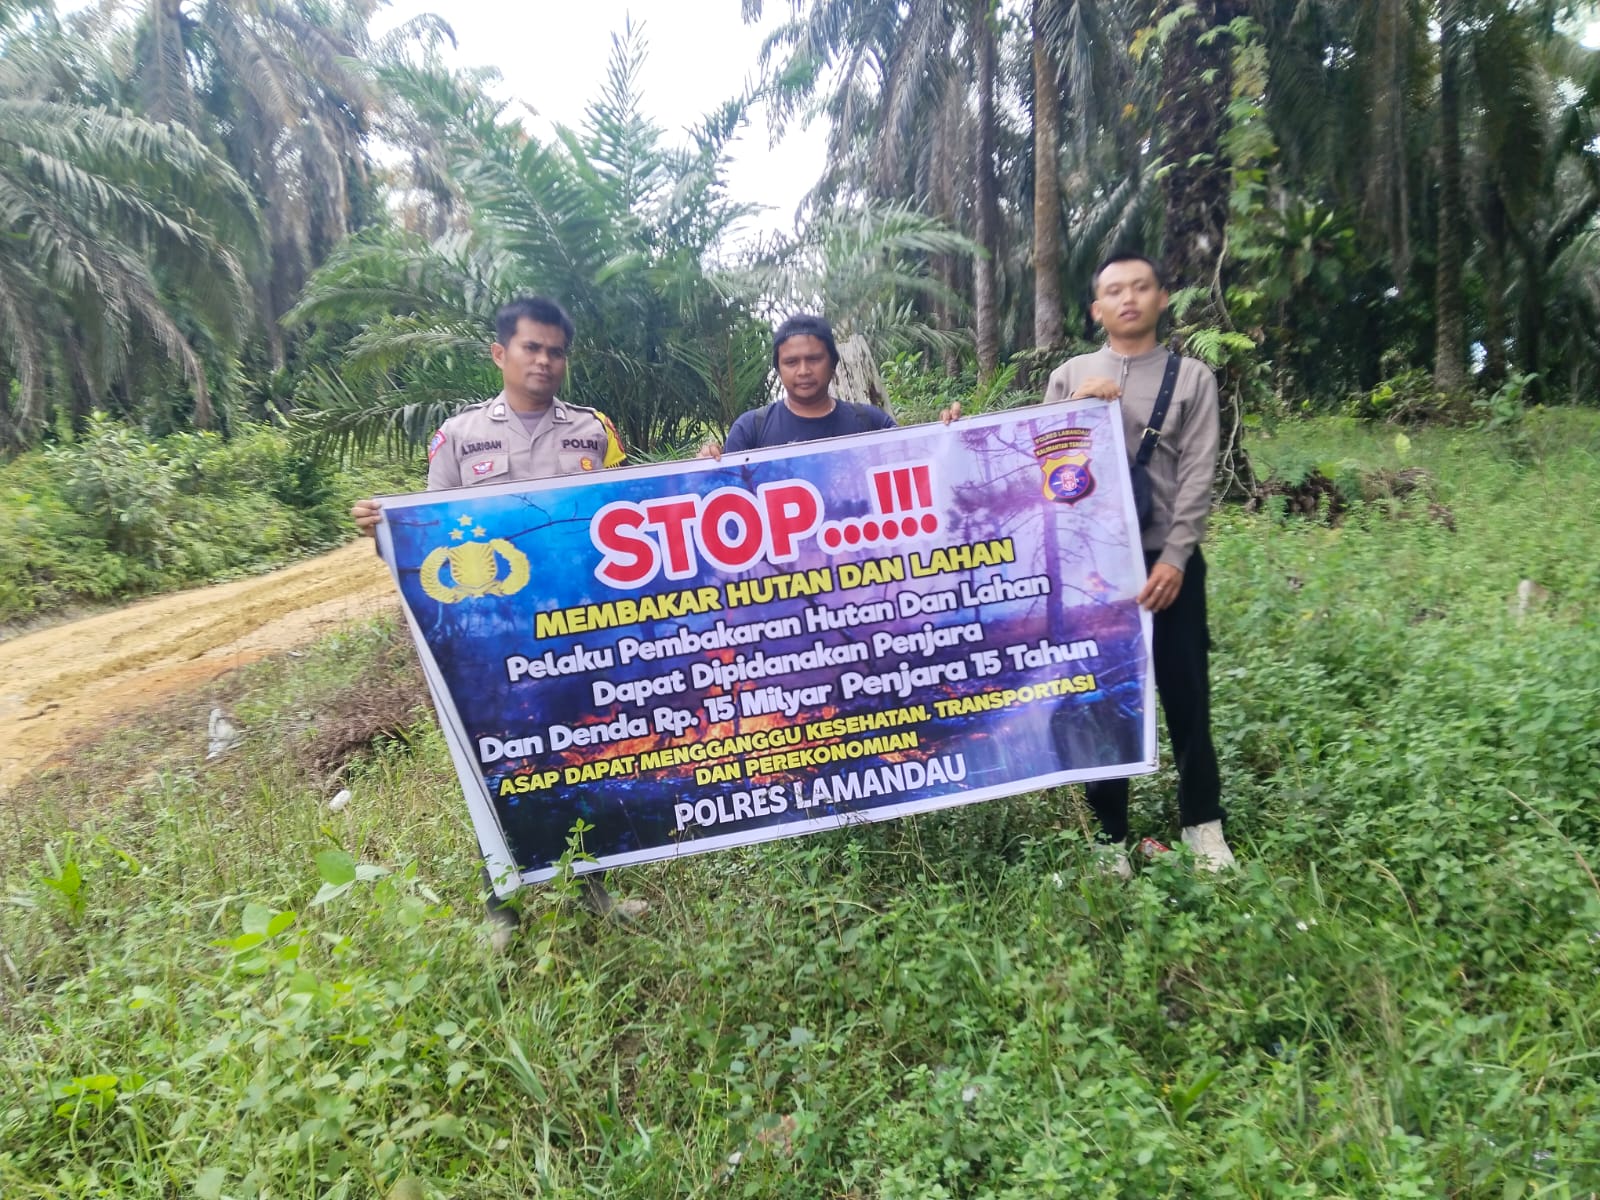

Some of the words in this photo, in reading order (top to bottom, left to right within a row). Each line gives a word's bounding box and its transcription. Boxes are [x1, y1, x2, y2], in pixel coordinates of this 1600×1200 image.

[562, 439, 598, 450] POLRI
[506, 644, 615, 682] Pelaku
[618, 614, 802, 665] Pembakaran
[805, 599, 894, 633] Hutan
[900, 588, 957, 618] Dan
[960, 573, 1051, 600] Lahan
[536, 588, 722, 639] MEMBAKAR
[727, 569, 833, 609] HUTAN
[839, 556, 905, 589] DAN
[910, 538, 1016, 577] LAHAN
[478, 735, 544, 763] Dan
[549, 713, 649, 751] Denda
[653, 706, 699, 735] Rp.
[703, 695, 735, 723] 15
[741, 684, 832, 718] Milyar
[841, 659, 968, 700] Penjara
[970, 649, 1002, 678] 15
[1006, 638, 1099, 672] Tahun
[592, 668, 687, 707] Dapat
[692, 640, 869, 690] Dipidanakan
[872, 622, 984, 658] Penjara
[500, 770, 560, 796] ASAP
[564, 756, 638, 786] DAPAT
[640, 728, 802, 771] MENGGANGGU
[935, 675, 1097, 719] TRANSPORTASI
[695, 762, 742, 786] DAN
[746, 731, 919, 775] PEREKONOMIAN
[674, 784, 788, 831] POLRES
[792, 752, 968, 810] LAMANDAU
